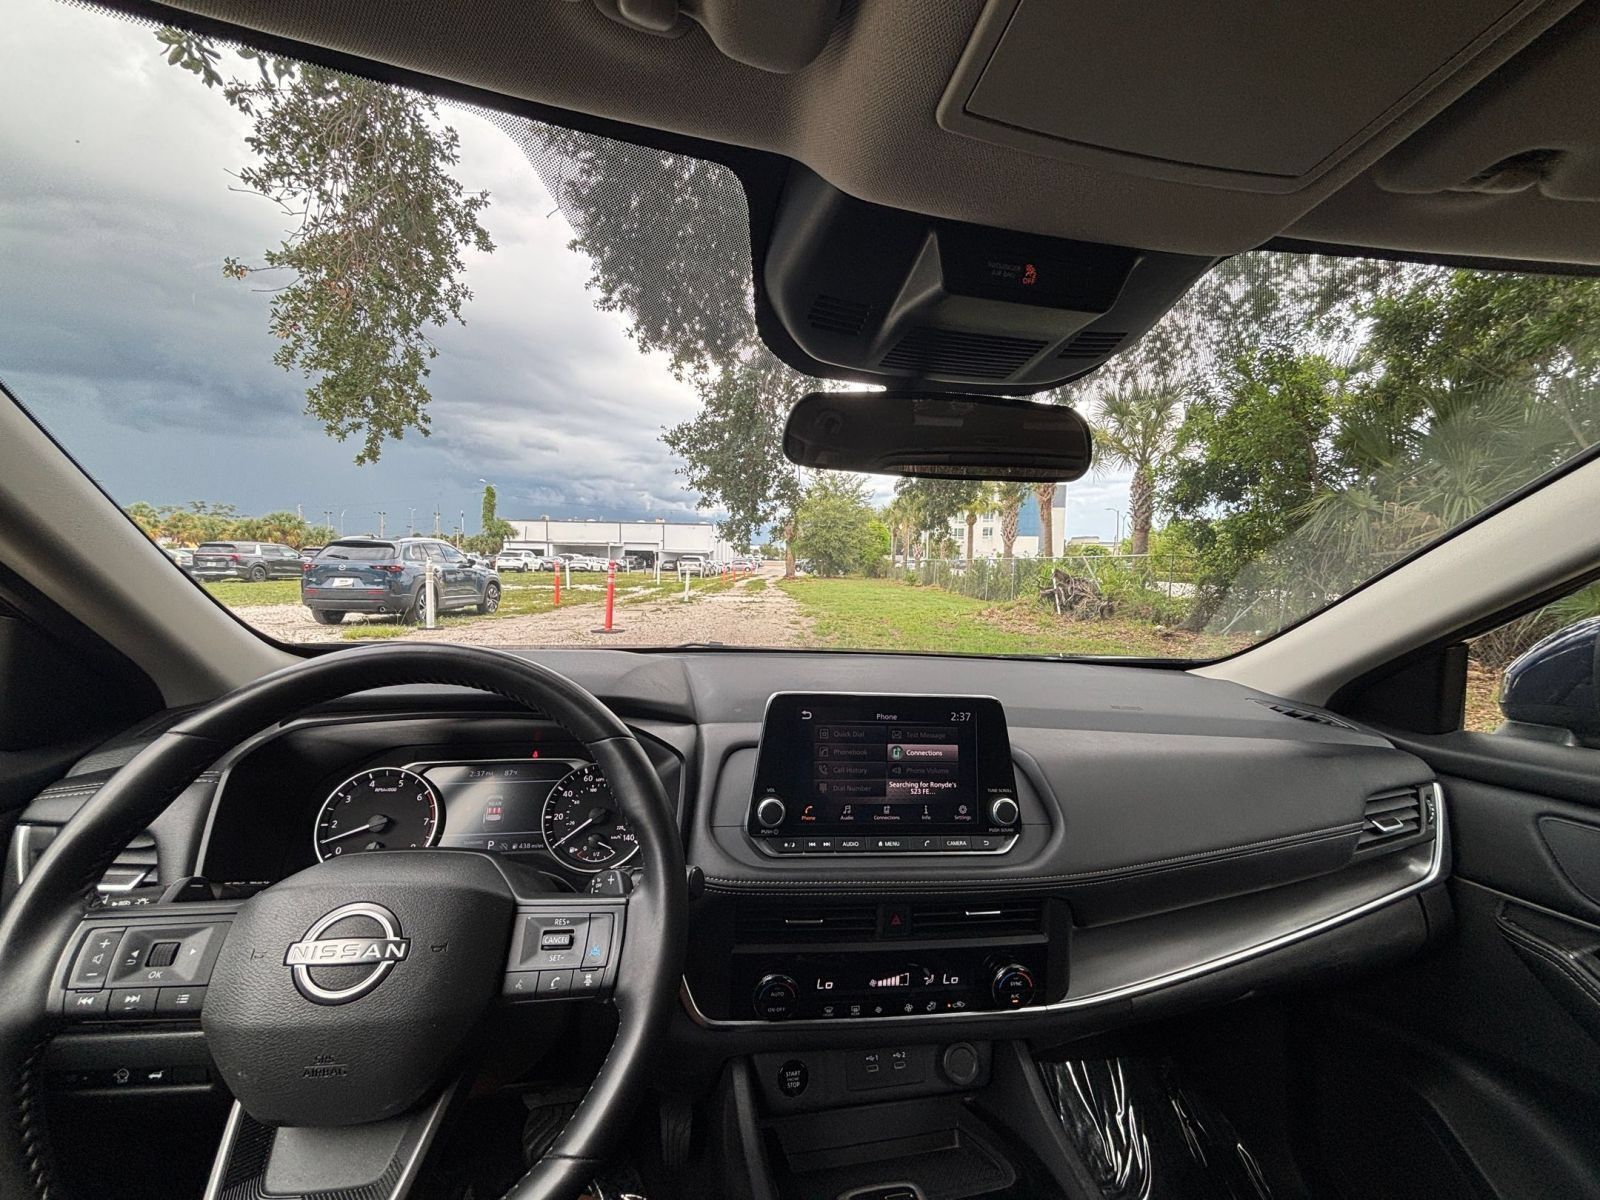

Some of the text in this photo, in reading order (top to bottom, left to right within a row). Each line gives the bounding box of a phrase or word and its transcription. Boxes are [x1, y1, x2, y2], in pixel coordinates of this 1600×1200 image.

[876, 713, 899, 721] Phone
[950, 711, 972, 722] 2:37
[905, 749, 943, 757] Connections
[469, 770, 485, 778] 2:37
[369, 780, 376, 788] 4
[583, 776, 593, 784] 60
[888, 781, 919, 789] Searching
[930, 781, 957, 790] Ronyde's
[345, 795, 352, 803] 3
[417, 793, 424, 801] 6
[954, 814, 972, 822] Settings
[331, 820, 338, 829] 2
[423, 818, 430, 828] 7
[622, 834, 635, 842] 140
[487, 840, 496, 850] P
[842, 840, 860, 848] AUDIO
[884, 840, 901, 848] MENU
[334, 846, 342, 855] 0
[554, 918, 571, 927] RES+
[544, 936, 569, 944] CANCEL
[290, 943, 406, 962] NISSAN
[148, 971, 163, 982] OK
[942, 973, 959, 984] Lo
[817, 978, 834, 990] Lo
[303, 1067, 347, 1078] AIRBAG
[785, 1070, 801, 1078] START
[786, 1081, 801, 1089] STOP
